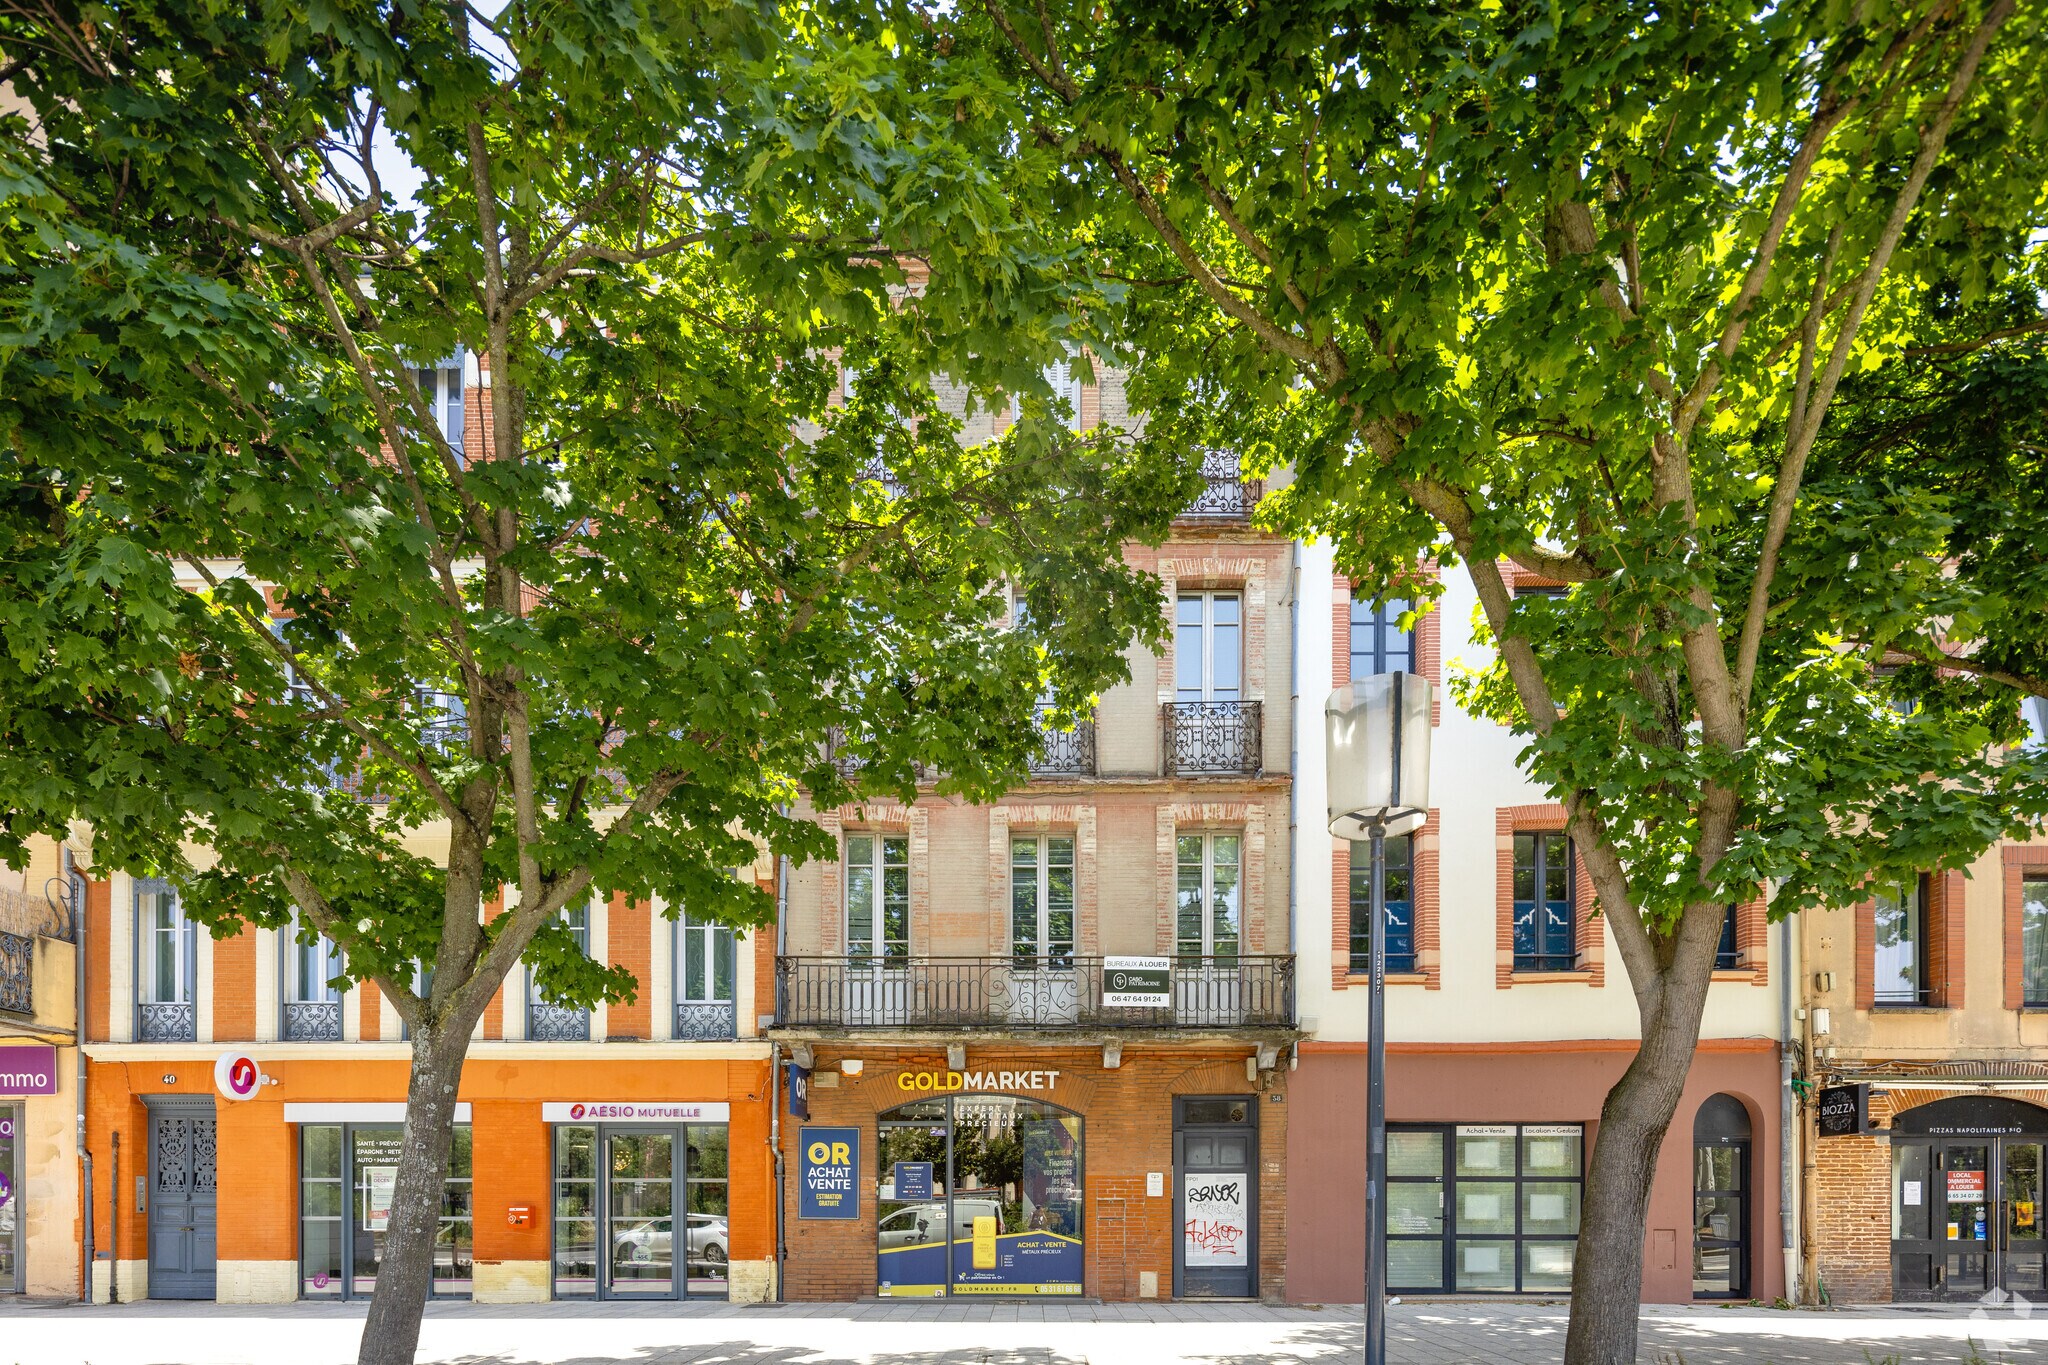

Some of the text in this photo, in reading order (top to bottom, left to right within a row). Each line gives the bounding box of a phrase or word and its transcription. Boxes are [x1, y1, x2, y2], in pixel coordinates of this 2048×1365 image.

[164, 1075, 175, 1084] 40
[898, 1070, 1059, 1091] GOLDMARKET
[796, 1076, 806, 1100] OR
[589, 1106, 700, 1117] AÉSIO MUTUELLE
[1822, 1103, 1855, 1116] BIOZZA
[808, 1142, 850, 1165] OR
[808, 1167, 851, 1177] ACHAT
[1054, 1169, 1072, 1177] projets
[808, 1179, 851, 1189] VENTE
